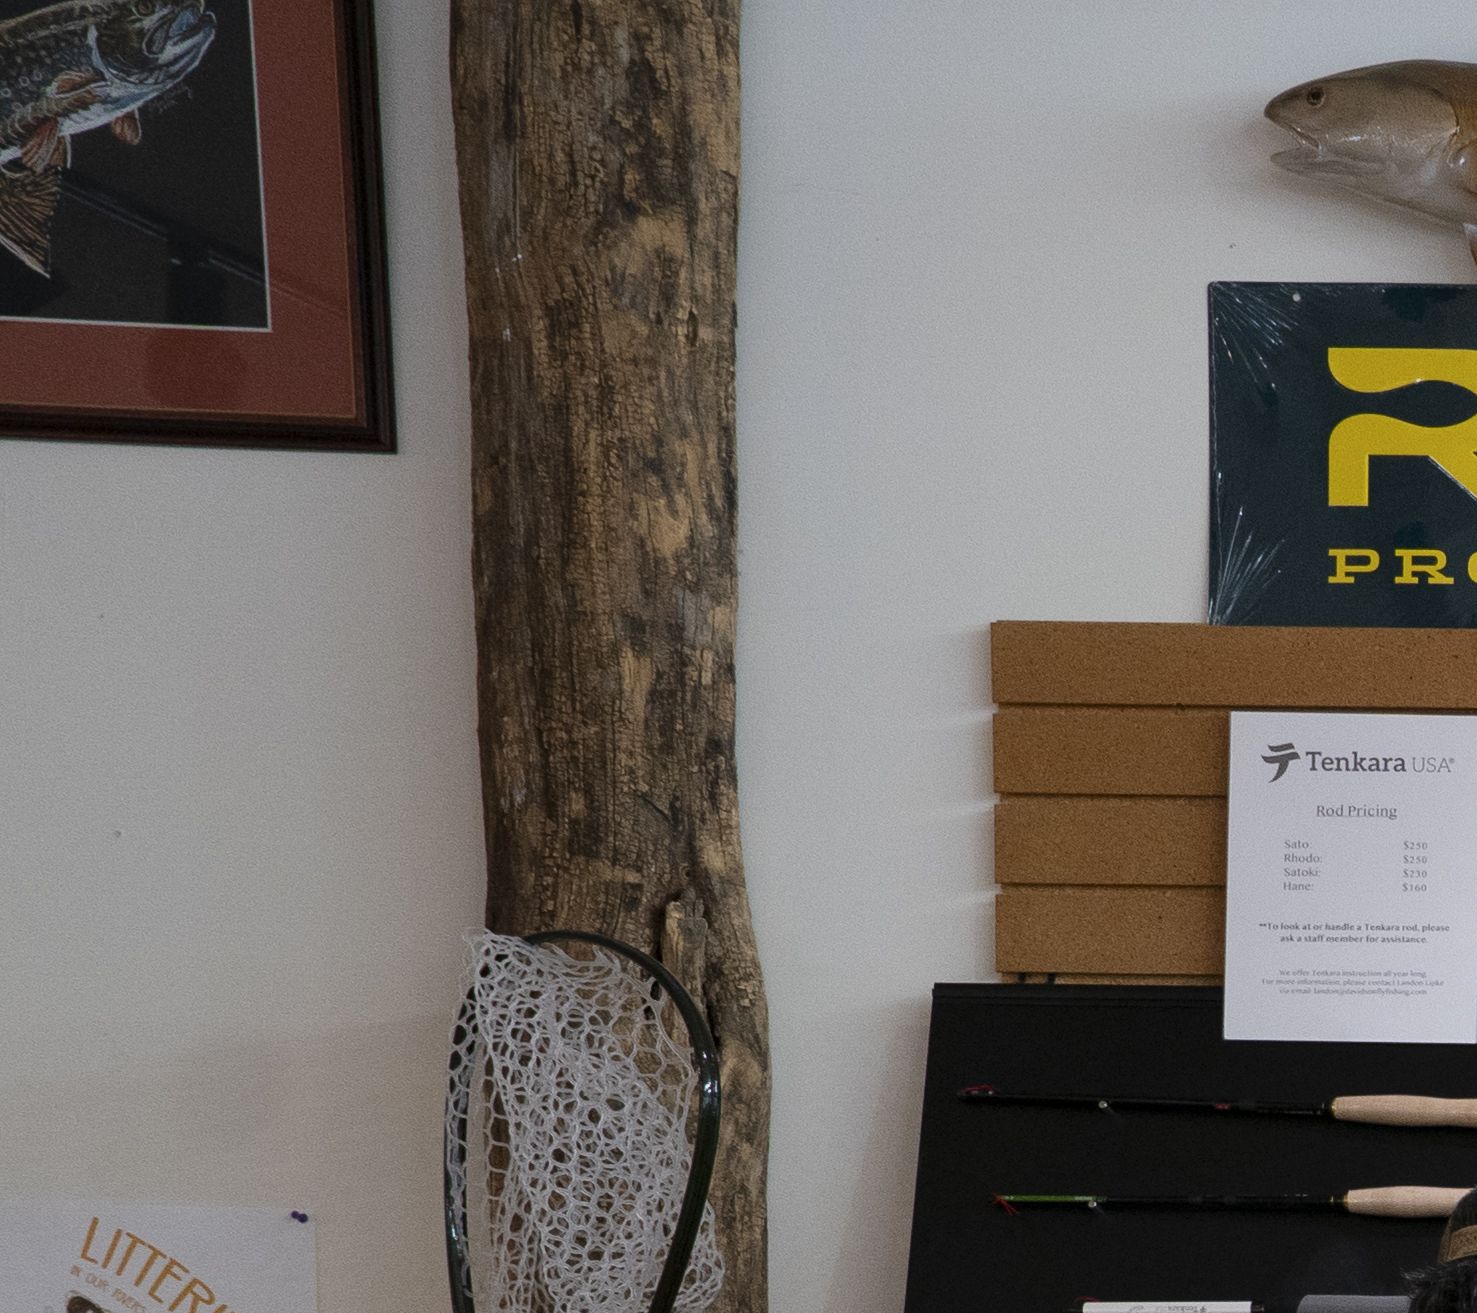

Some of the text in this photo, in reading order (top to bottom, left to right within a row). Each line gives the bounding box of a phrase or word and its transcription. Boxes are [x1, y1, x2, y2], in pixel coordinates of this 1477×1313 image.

[1306, 751, 1407, 772] Tenkara
[1316, 804, 1398, 820] Rod Pricing
[1403, 841, 1428, 850] $250
[1284, 853, 1428, 864] Rhodo: $250
[1284, 867, 1428, 878] Satoki: $230
[1283, 881, 1428, 892] Hane: $160
[1280, 922, 1300, 931] look
[1302, 923, 1311, 931] at
[1325, 923, 1354, 931] handle
[1365, 923, 1400, 932] Tenkara
[1422, 924, 1450, 933] please
[1280, 934, 1294, 943] ask
[1304, 934, 1323, 943] staff
[1326, 935, 1363, 944] member
[1365, 935, 1379, 944] for
